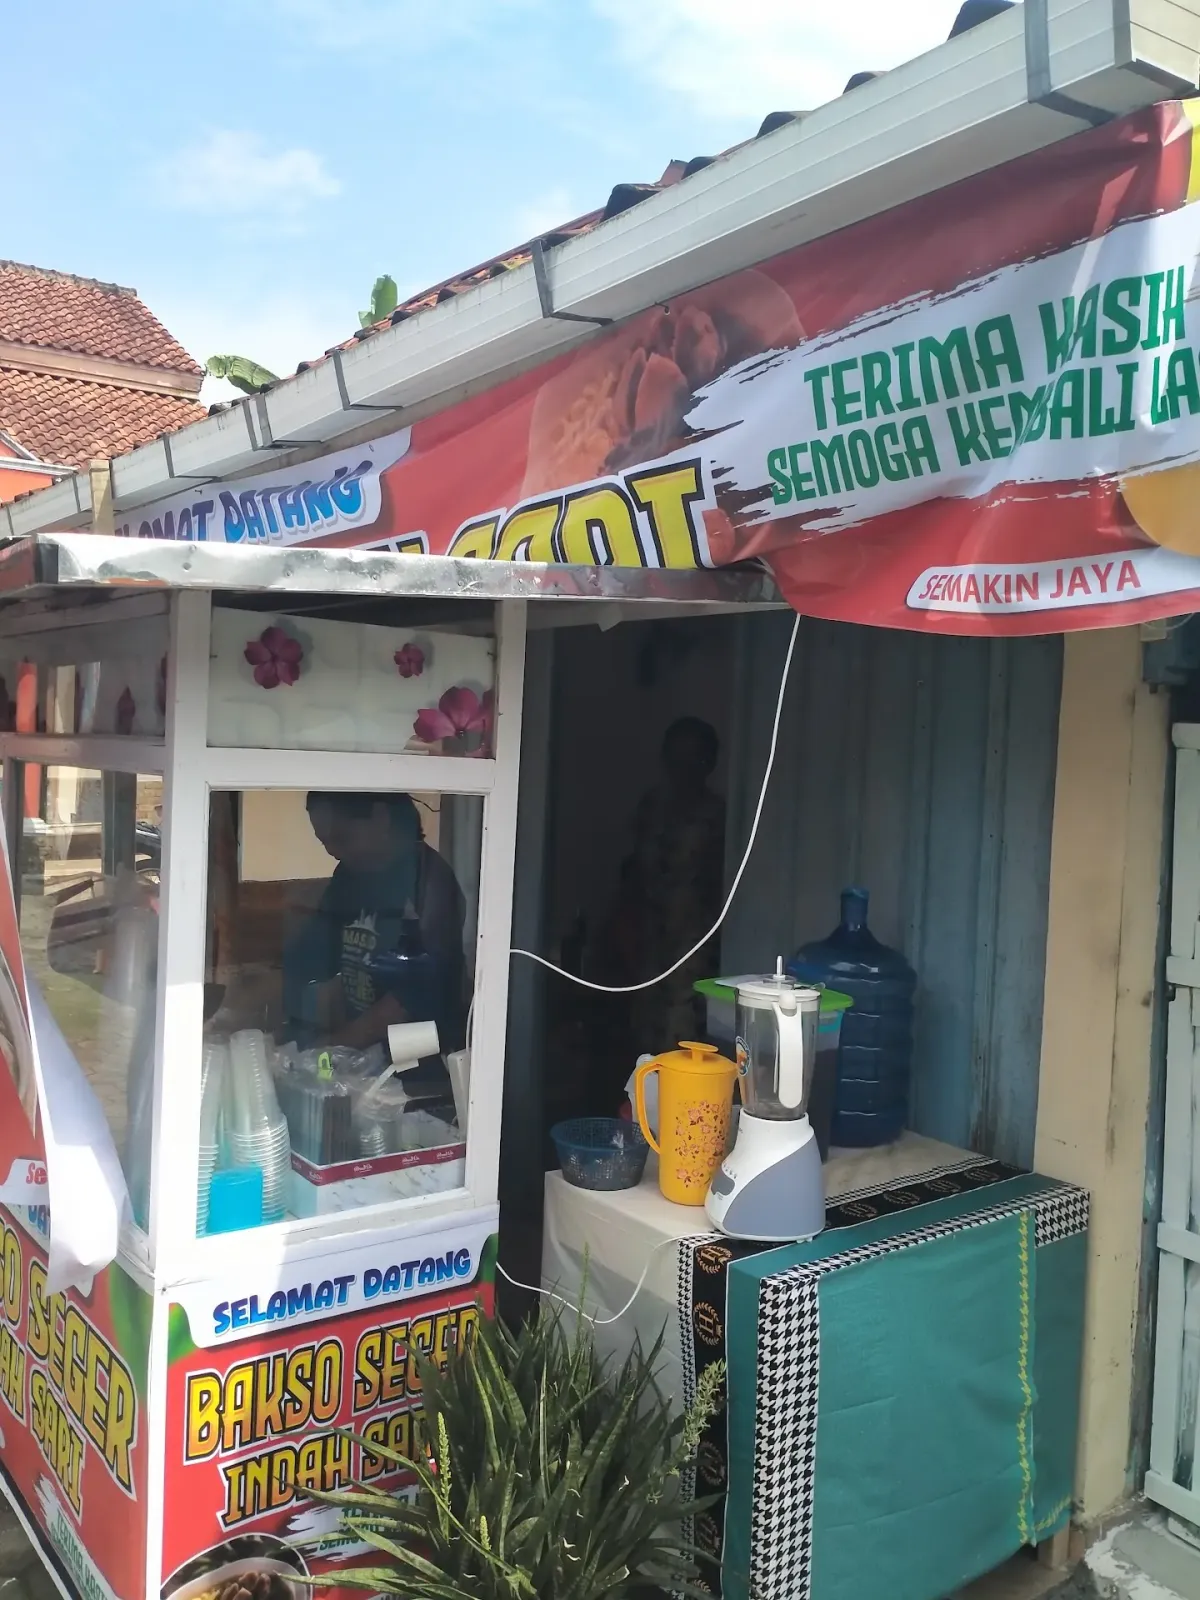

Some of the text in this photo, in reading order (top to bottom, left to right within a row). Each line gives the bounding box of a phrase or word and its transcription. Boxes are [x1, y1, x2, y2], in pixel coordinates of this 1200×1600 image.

[804, 265, 1186, 430] TERIMA KASIH
[767, 413, 940, 506] SEMOGA
[1151, 346, 1200, 426] LA
[218, 459, 374, 544] DATANG
[918, 559, 1142, 605] SEMAKIN JAYA
[212, 1248, 471, 1335] SELAMAT DATANG
[27, 1257, 138, 1500] SEGER
[184, 1340, 344, 1464] BAKSO
[31, 1366, 85, 1521] SARI
[218, 1428, 354, 1531] INDAH
